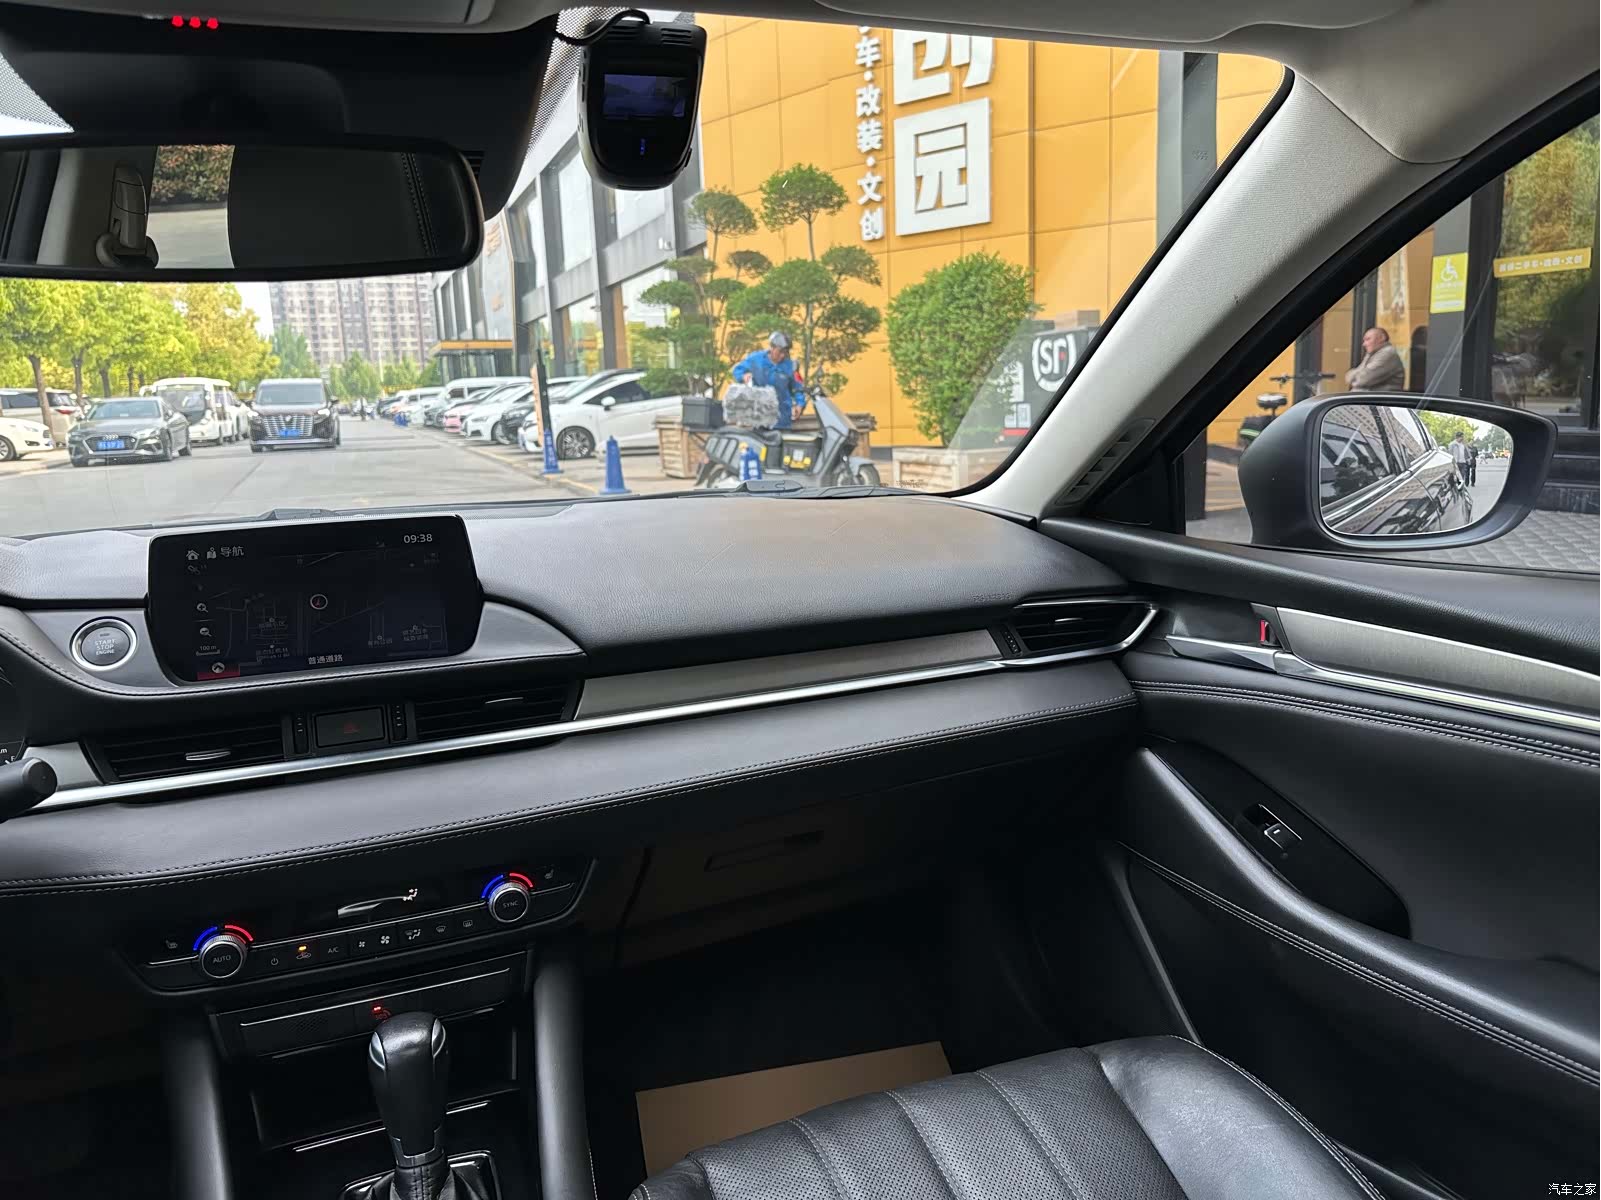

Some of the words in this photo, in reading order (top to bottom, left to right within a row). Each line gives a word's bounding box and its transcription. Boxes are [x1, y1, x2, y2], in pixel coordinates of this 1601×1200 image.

[403, 533, 433, 544] 09:38
[219, 545, 245, 558] 导航
[94, 638, 116, 646] START
[307, 653, 343, 665] 普通道路
[502, 900, 519, 909] SYNC
[327, 946, 339, 954] A/C
[212, 954, 232, 964] AUTO
